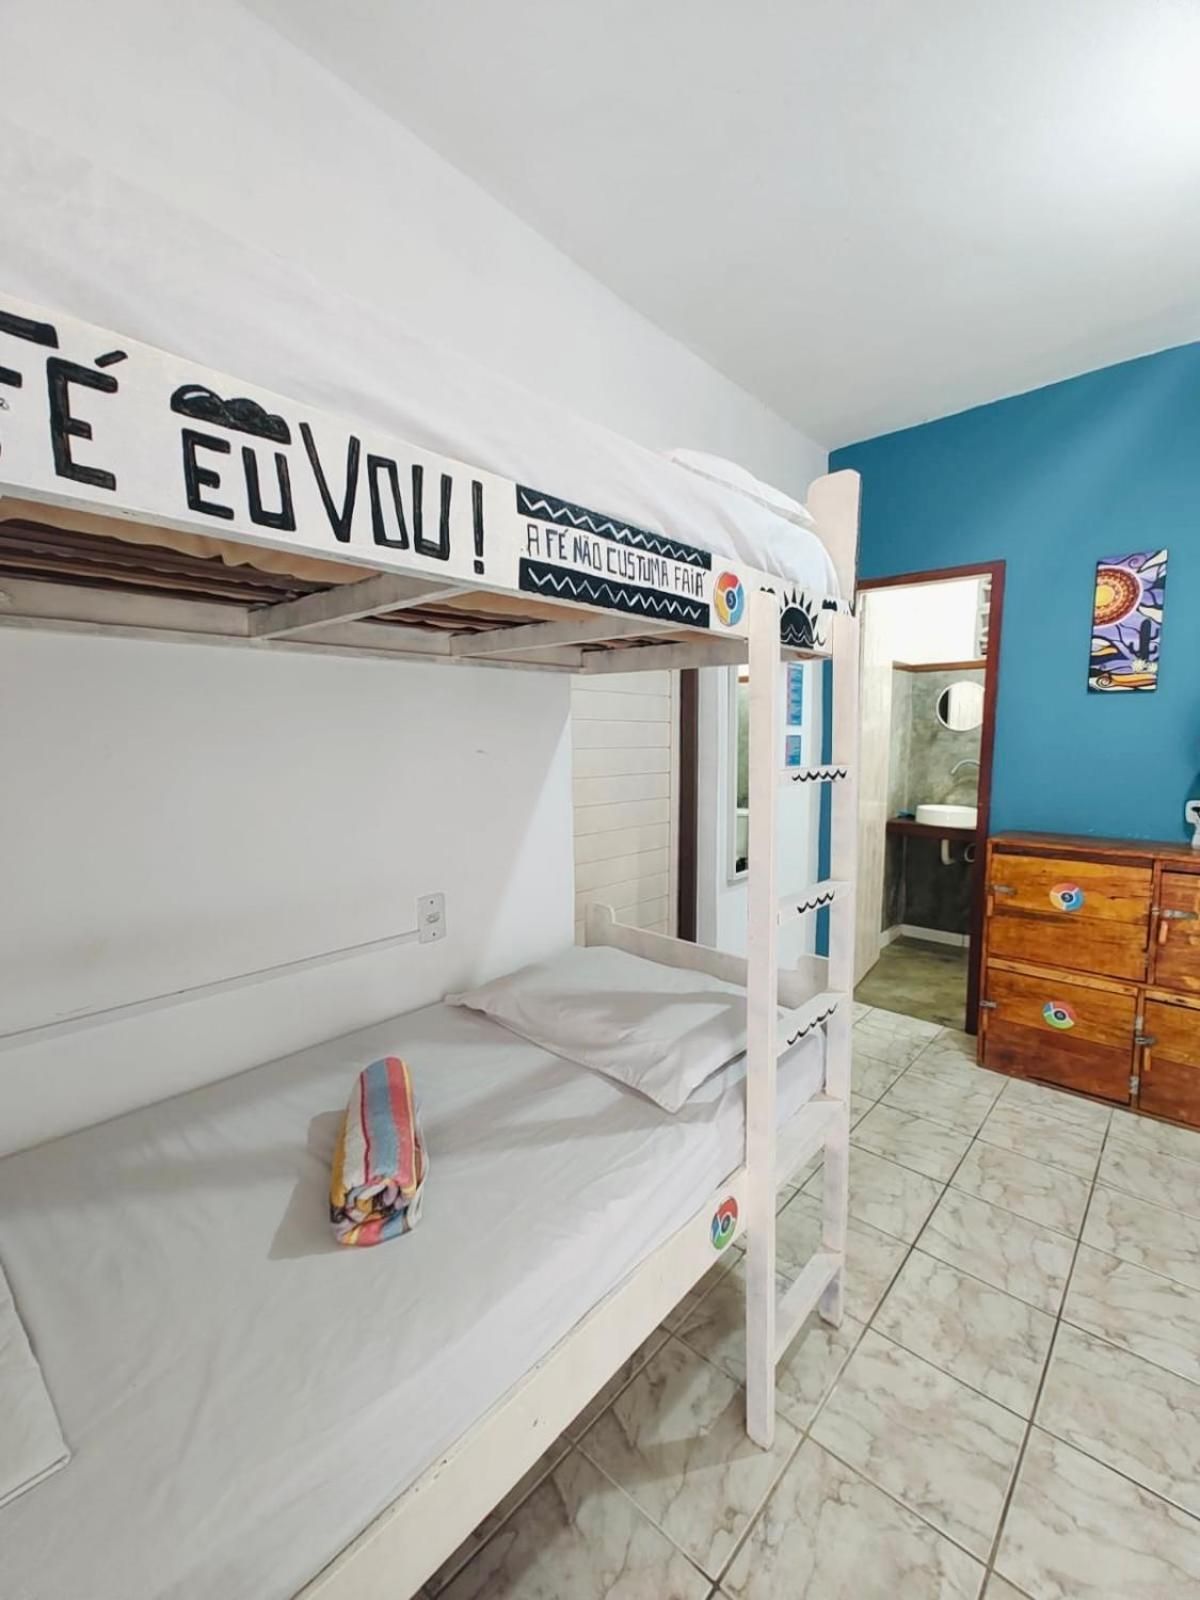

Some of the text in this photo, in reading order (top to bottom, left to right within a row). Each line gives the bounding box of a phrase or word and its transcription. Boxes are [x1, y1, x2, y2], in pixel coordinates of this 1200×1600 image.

[527, 523, 540, 557] A
[545, 528, 569, 561] FÉ
[573, 534, 602, 572] NÃO
